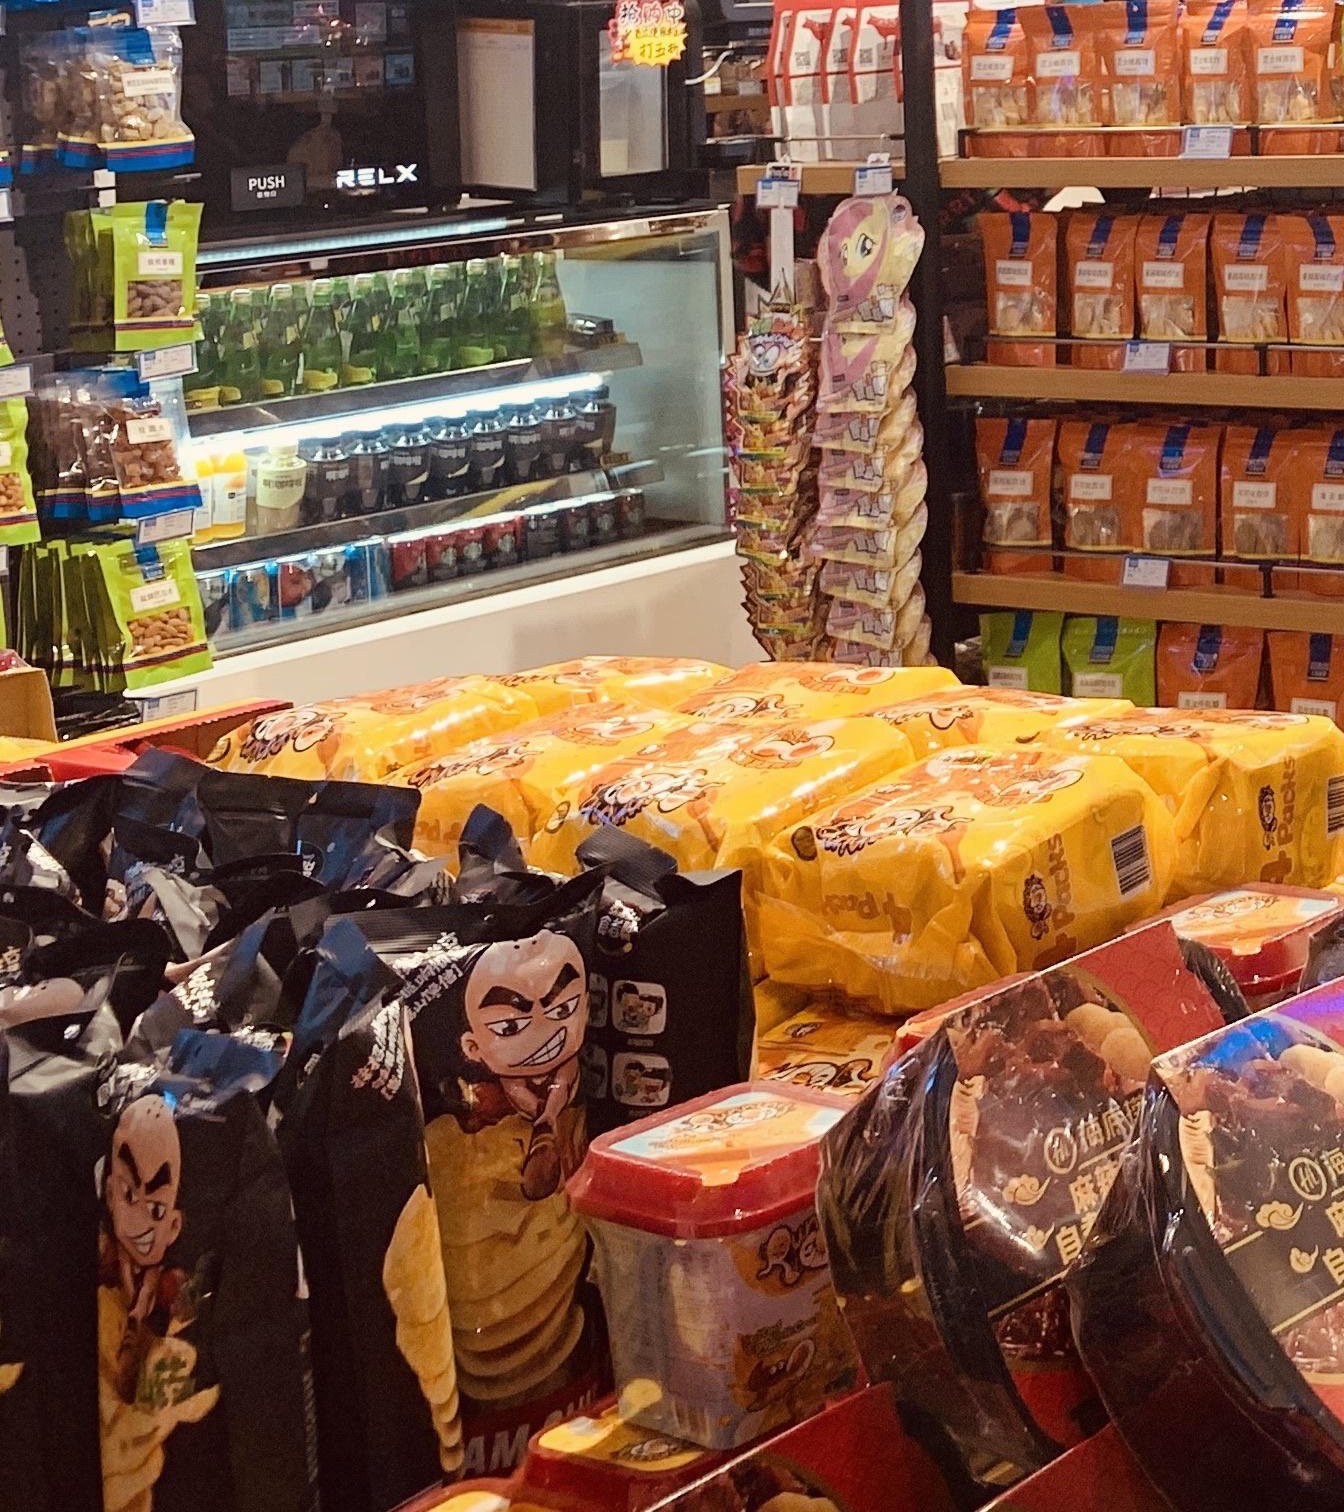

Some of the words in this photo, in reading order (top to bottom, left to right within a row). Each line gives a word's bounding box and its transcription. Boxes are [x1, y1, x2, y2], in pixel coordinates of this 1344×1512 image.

[249, 175, 285, 191] PUSH
[336, 163, 418, 188] RELX
[1277, 756, 1296, 846] Packs
[1047, 833, 1076, 930] Packs
